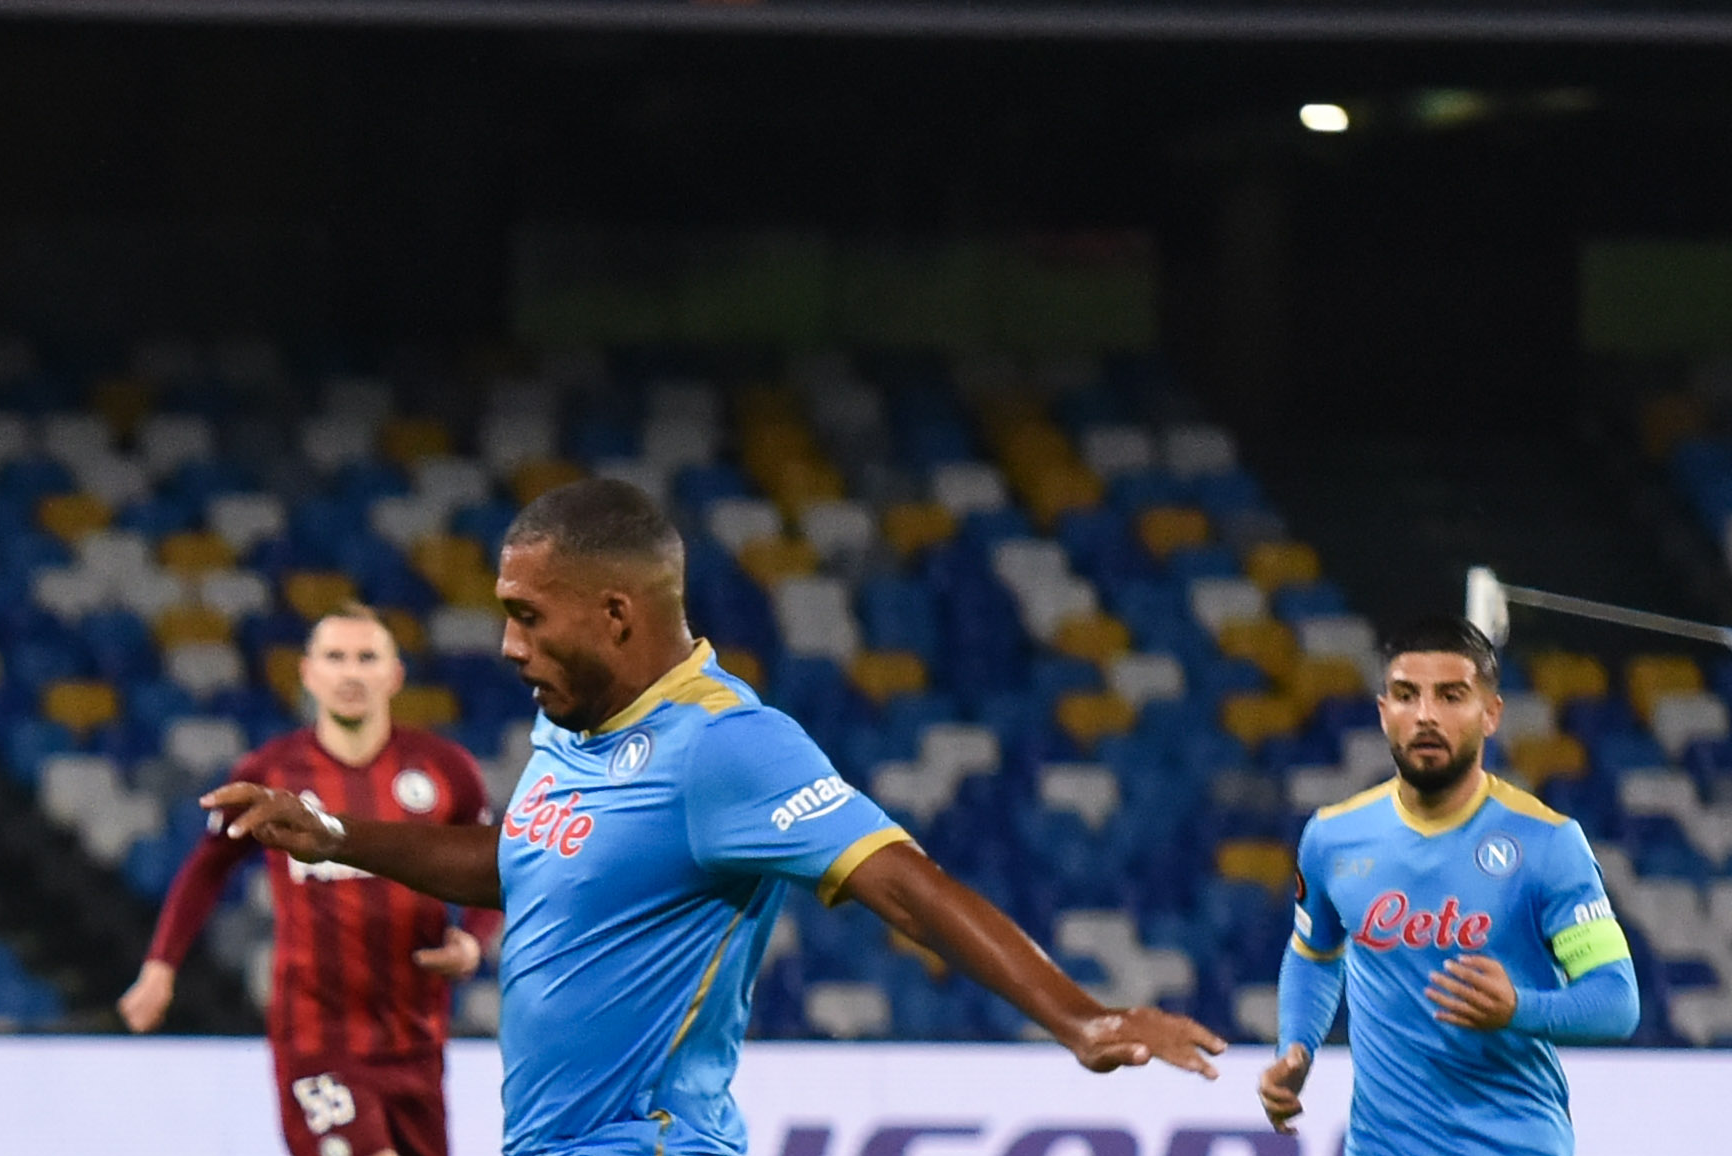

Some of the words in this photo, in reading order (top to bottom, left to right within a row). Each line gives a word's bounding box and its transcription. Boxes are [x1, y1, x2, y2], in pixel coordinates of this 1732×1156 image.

[619, 743, 644, 769] N
[502, 774, 594, 859] Lete
[1486, 843, 1510, 868] N
[1353, 889, 1493, 950] Lete
